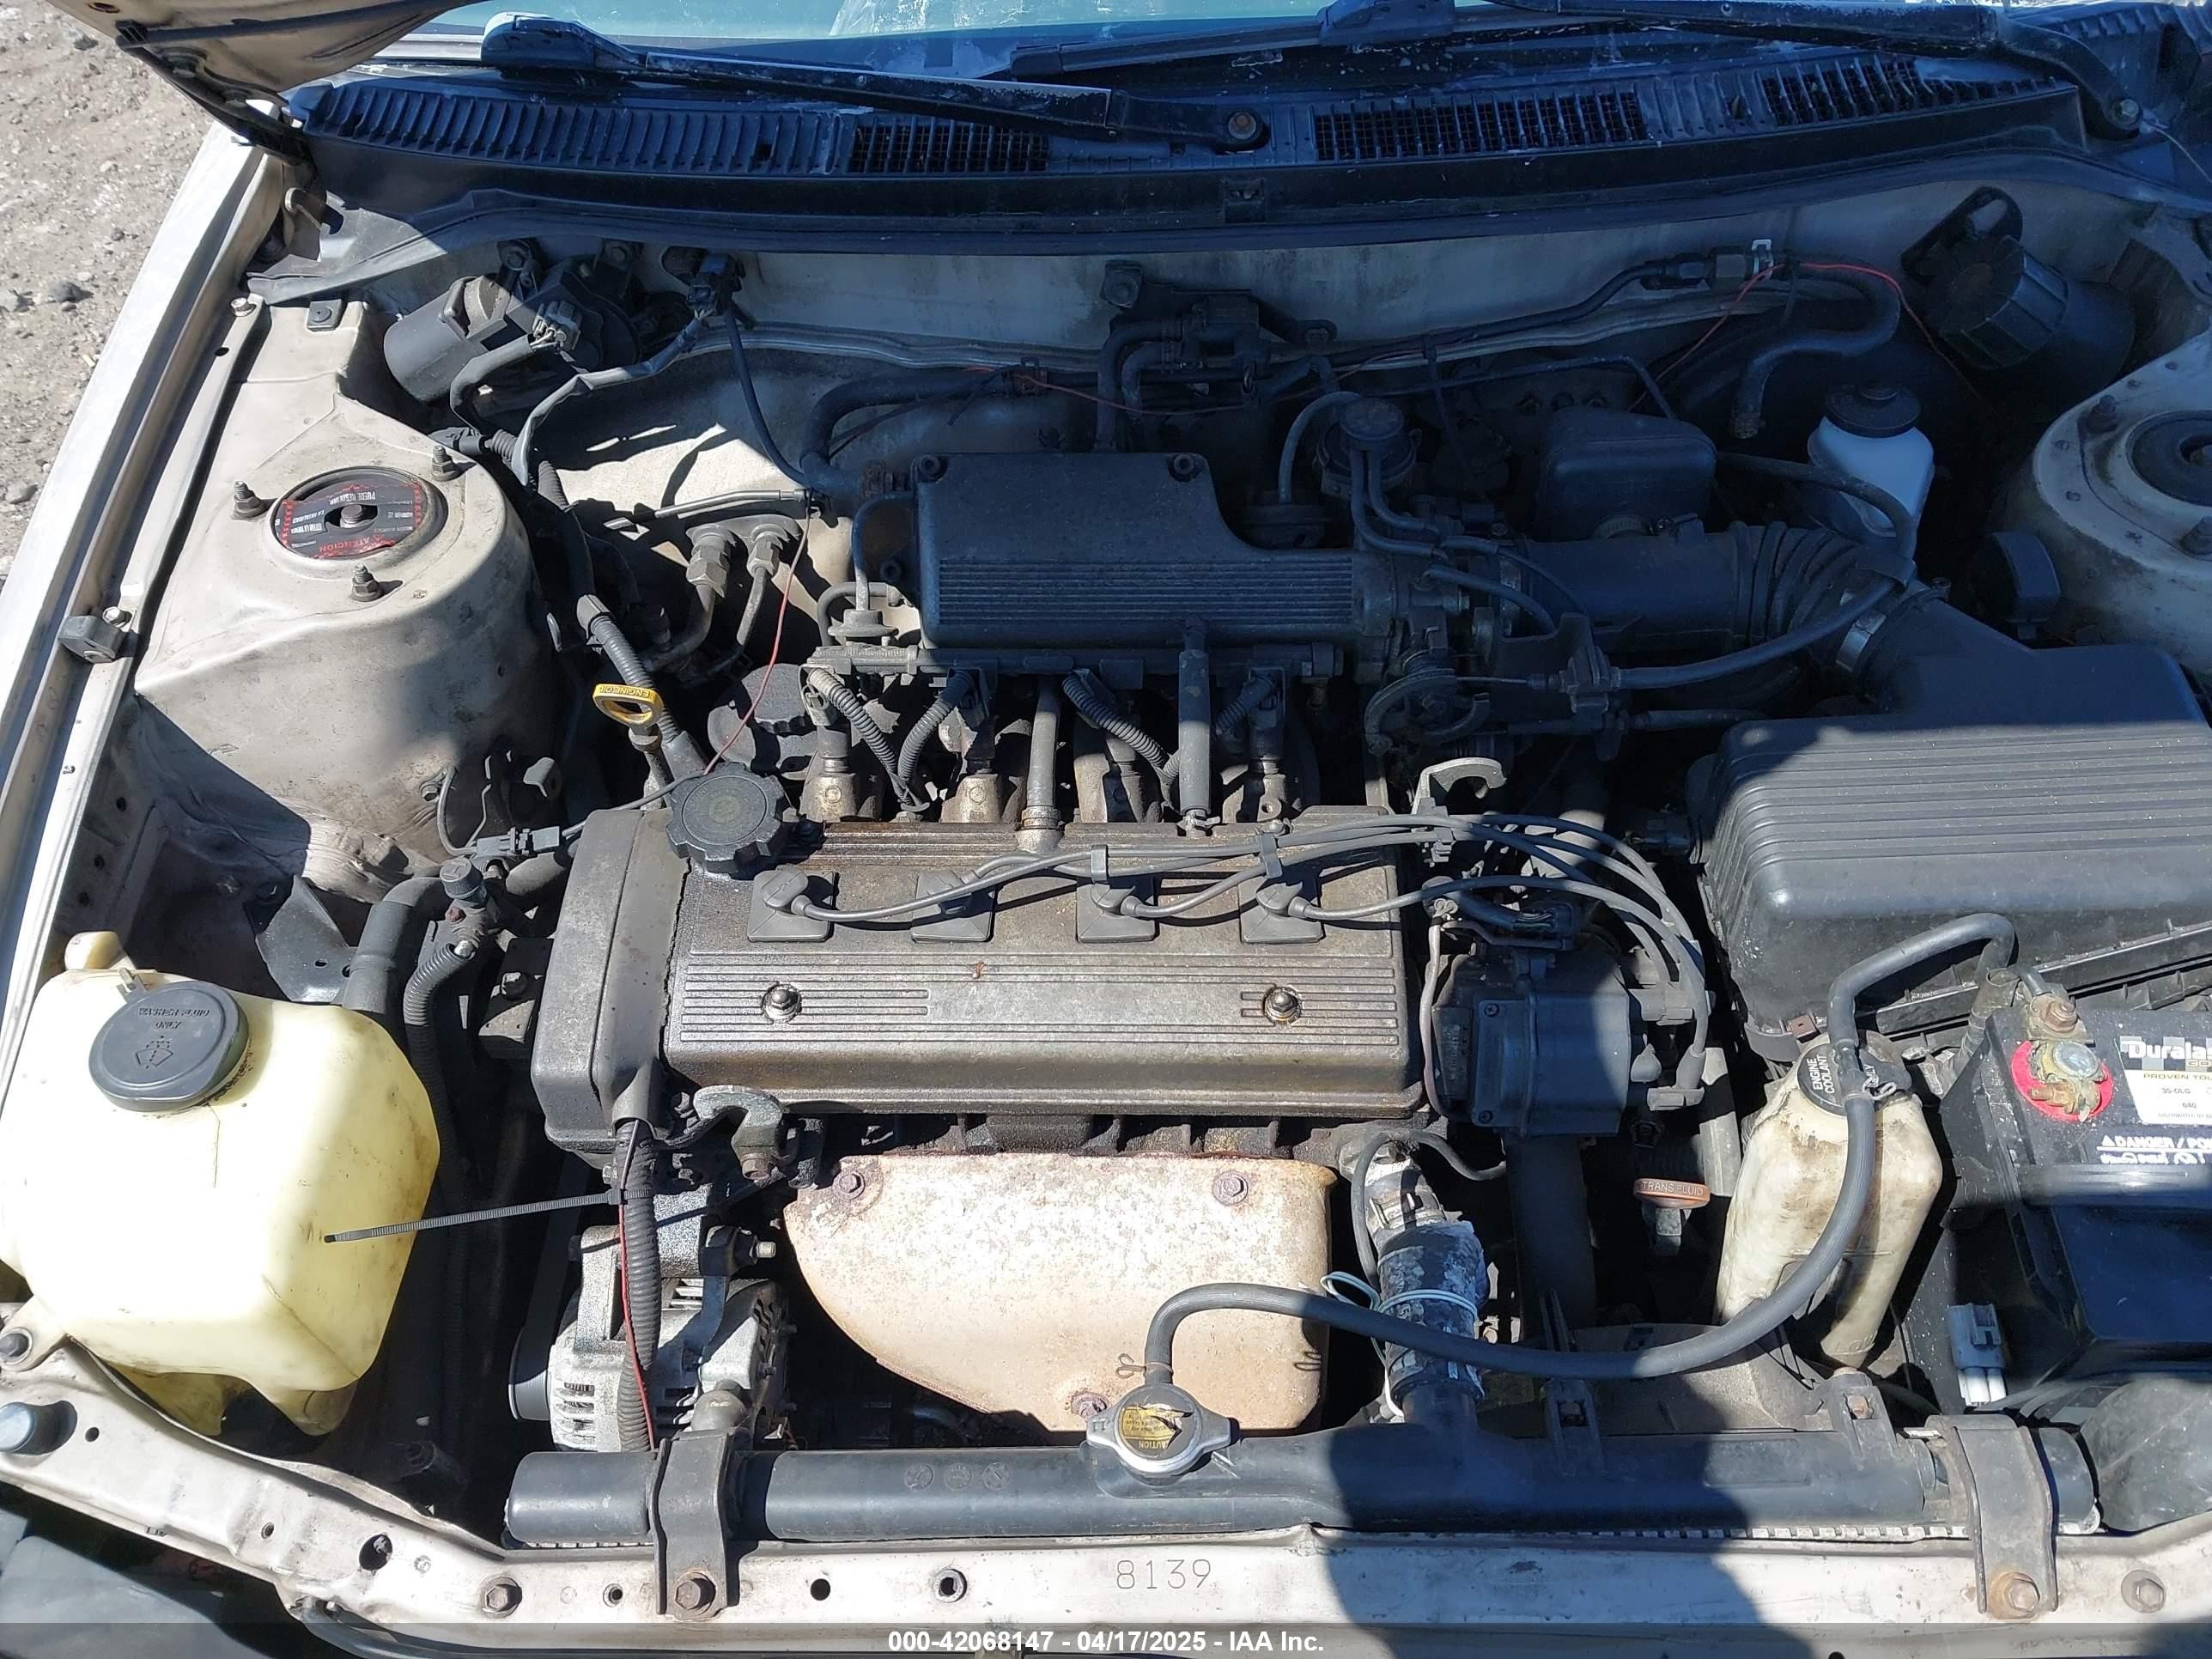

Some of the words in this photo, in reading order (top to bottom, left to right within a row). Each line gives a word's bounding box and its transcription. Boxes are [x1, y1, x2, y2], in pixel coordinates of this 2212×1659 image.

[180, 1009, 210, 1018] FLUID
[155, 1020, 182, 1030] ONLY
[1807, 1058, 1824, 1091] ENGINE
[1816, 1054, 1836, 1094] COOLANT
[2114, 1135, 2175, 1148] DANGER
[1642, 1181, 1674, 1193] TRANS
[1676, 1184, 1704, 1196] FLUID
[1138, 1440, 1169, 1449] AUTION
[1116, 1559, 1211, 1589] 8139
